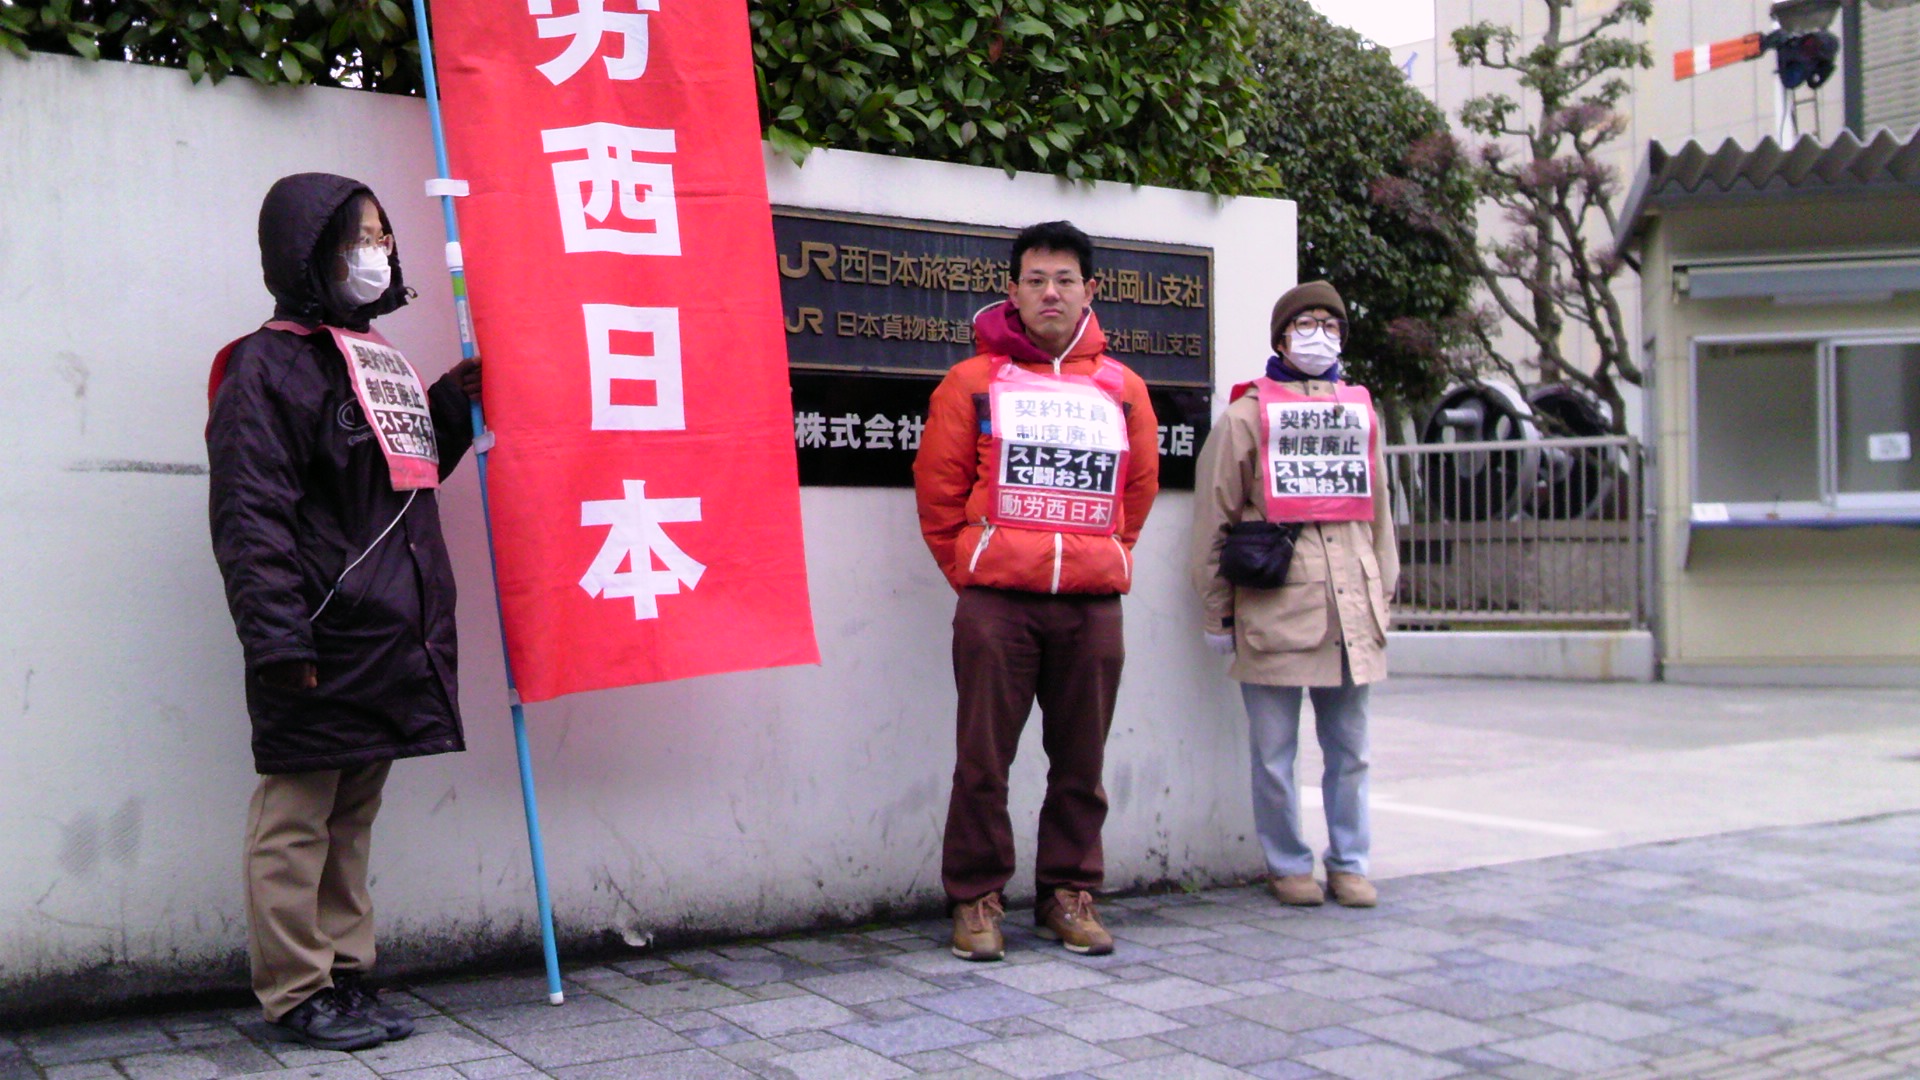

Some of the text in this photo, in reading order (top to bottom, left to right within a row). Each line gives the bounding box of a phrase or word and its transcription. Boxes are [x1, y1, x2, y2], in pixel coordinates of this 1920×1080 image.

[779, 241, 837, 281] JR
[785, 307, 824, 335] JR
[837, 312, 976, 344] 日本貨物鉄道
[1015, 399, 1108, 424] 契約社員
[795, 411, 924, 450] 株式会社
[1009, 446, 1113, 472] ストライキ
[1277, 461, 1364, 477] ストライキ
[1001, 494, 1108, 524] 動労西日本
